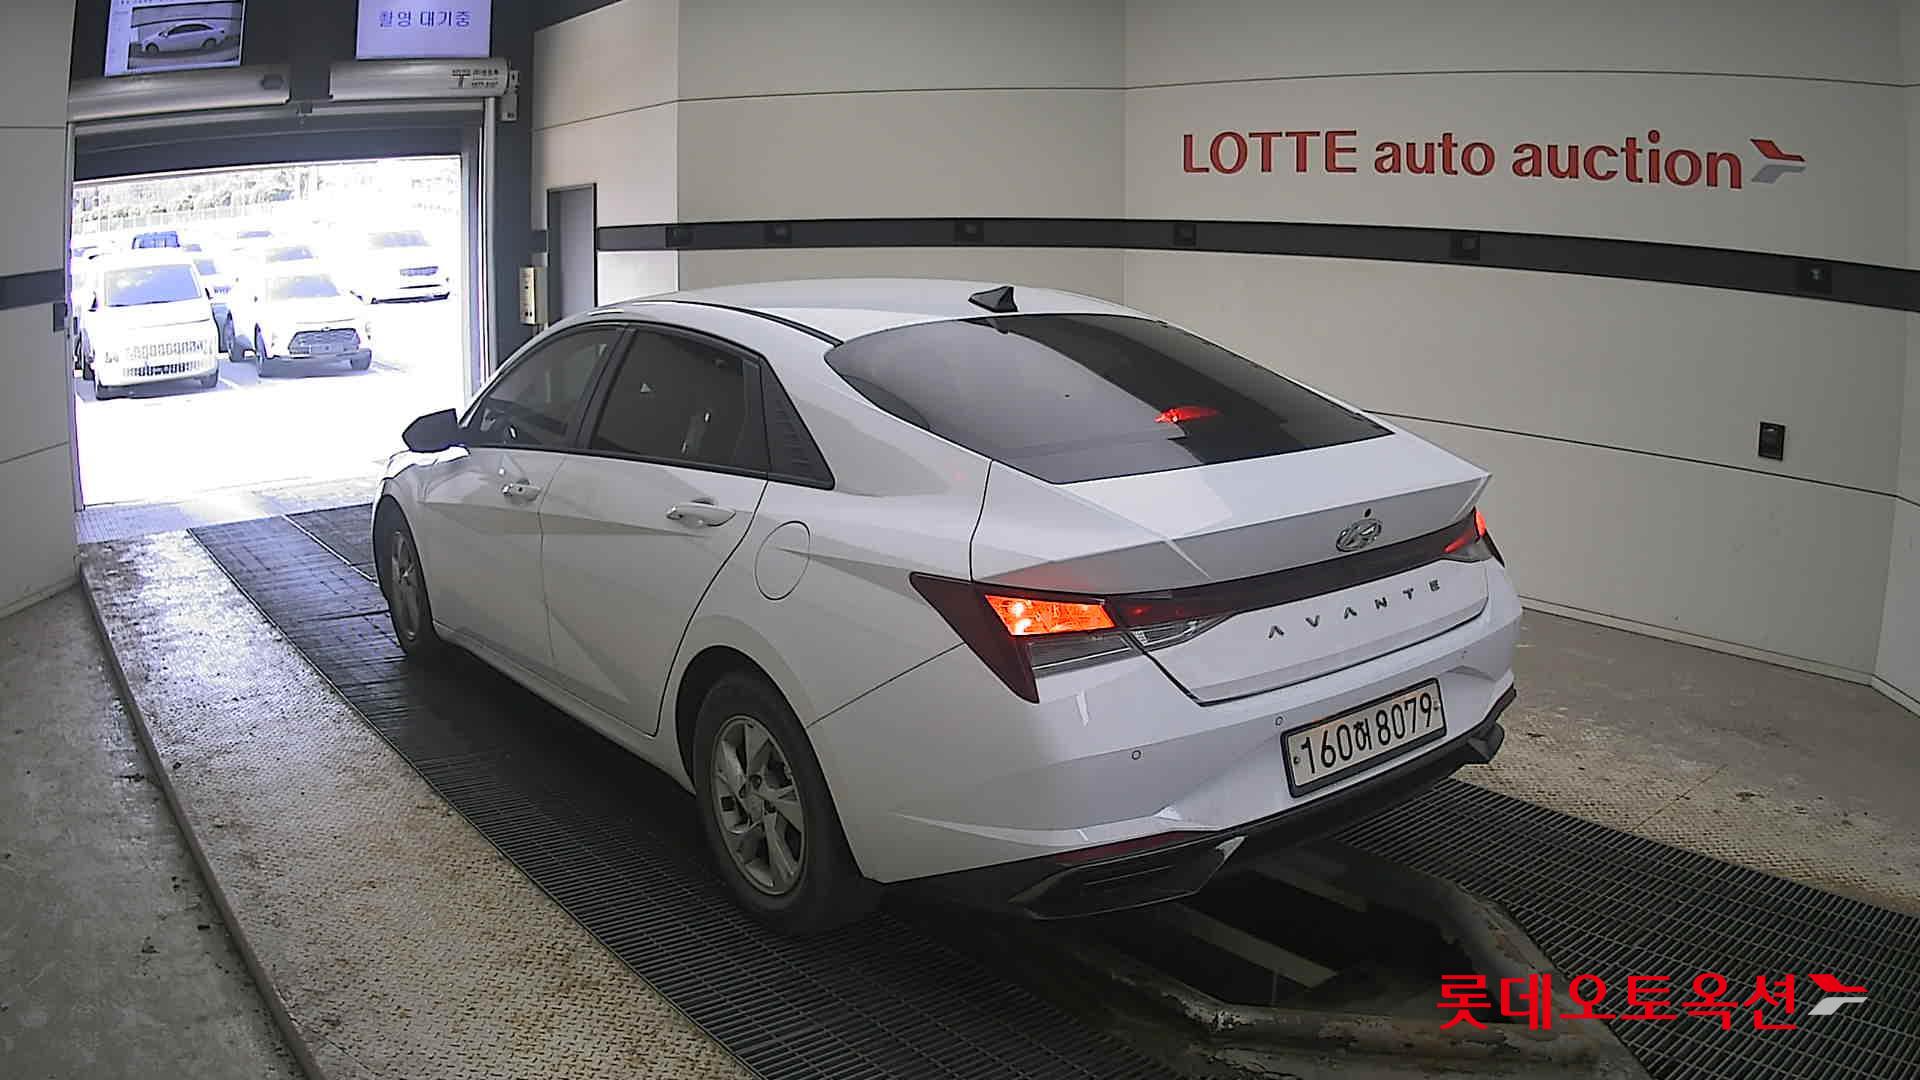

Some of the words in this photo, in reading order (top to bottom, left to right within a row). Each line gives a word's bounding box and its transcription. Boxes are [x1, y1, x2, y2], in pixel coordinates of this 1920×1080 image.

[420, 10, 470, 28] 대기중
[1183, 131, 1358, 174] LOTTE
[1375, 134, 1497, 176] auto
[1512, 130, 1743, 189] auction
[1267, 579, 1441, 639] AVANTE
